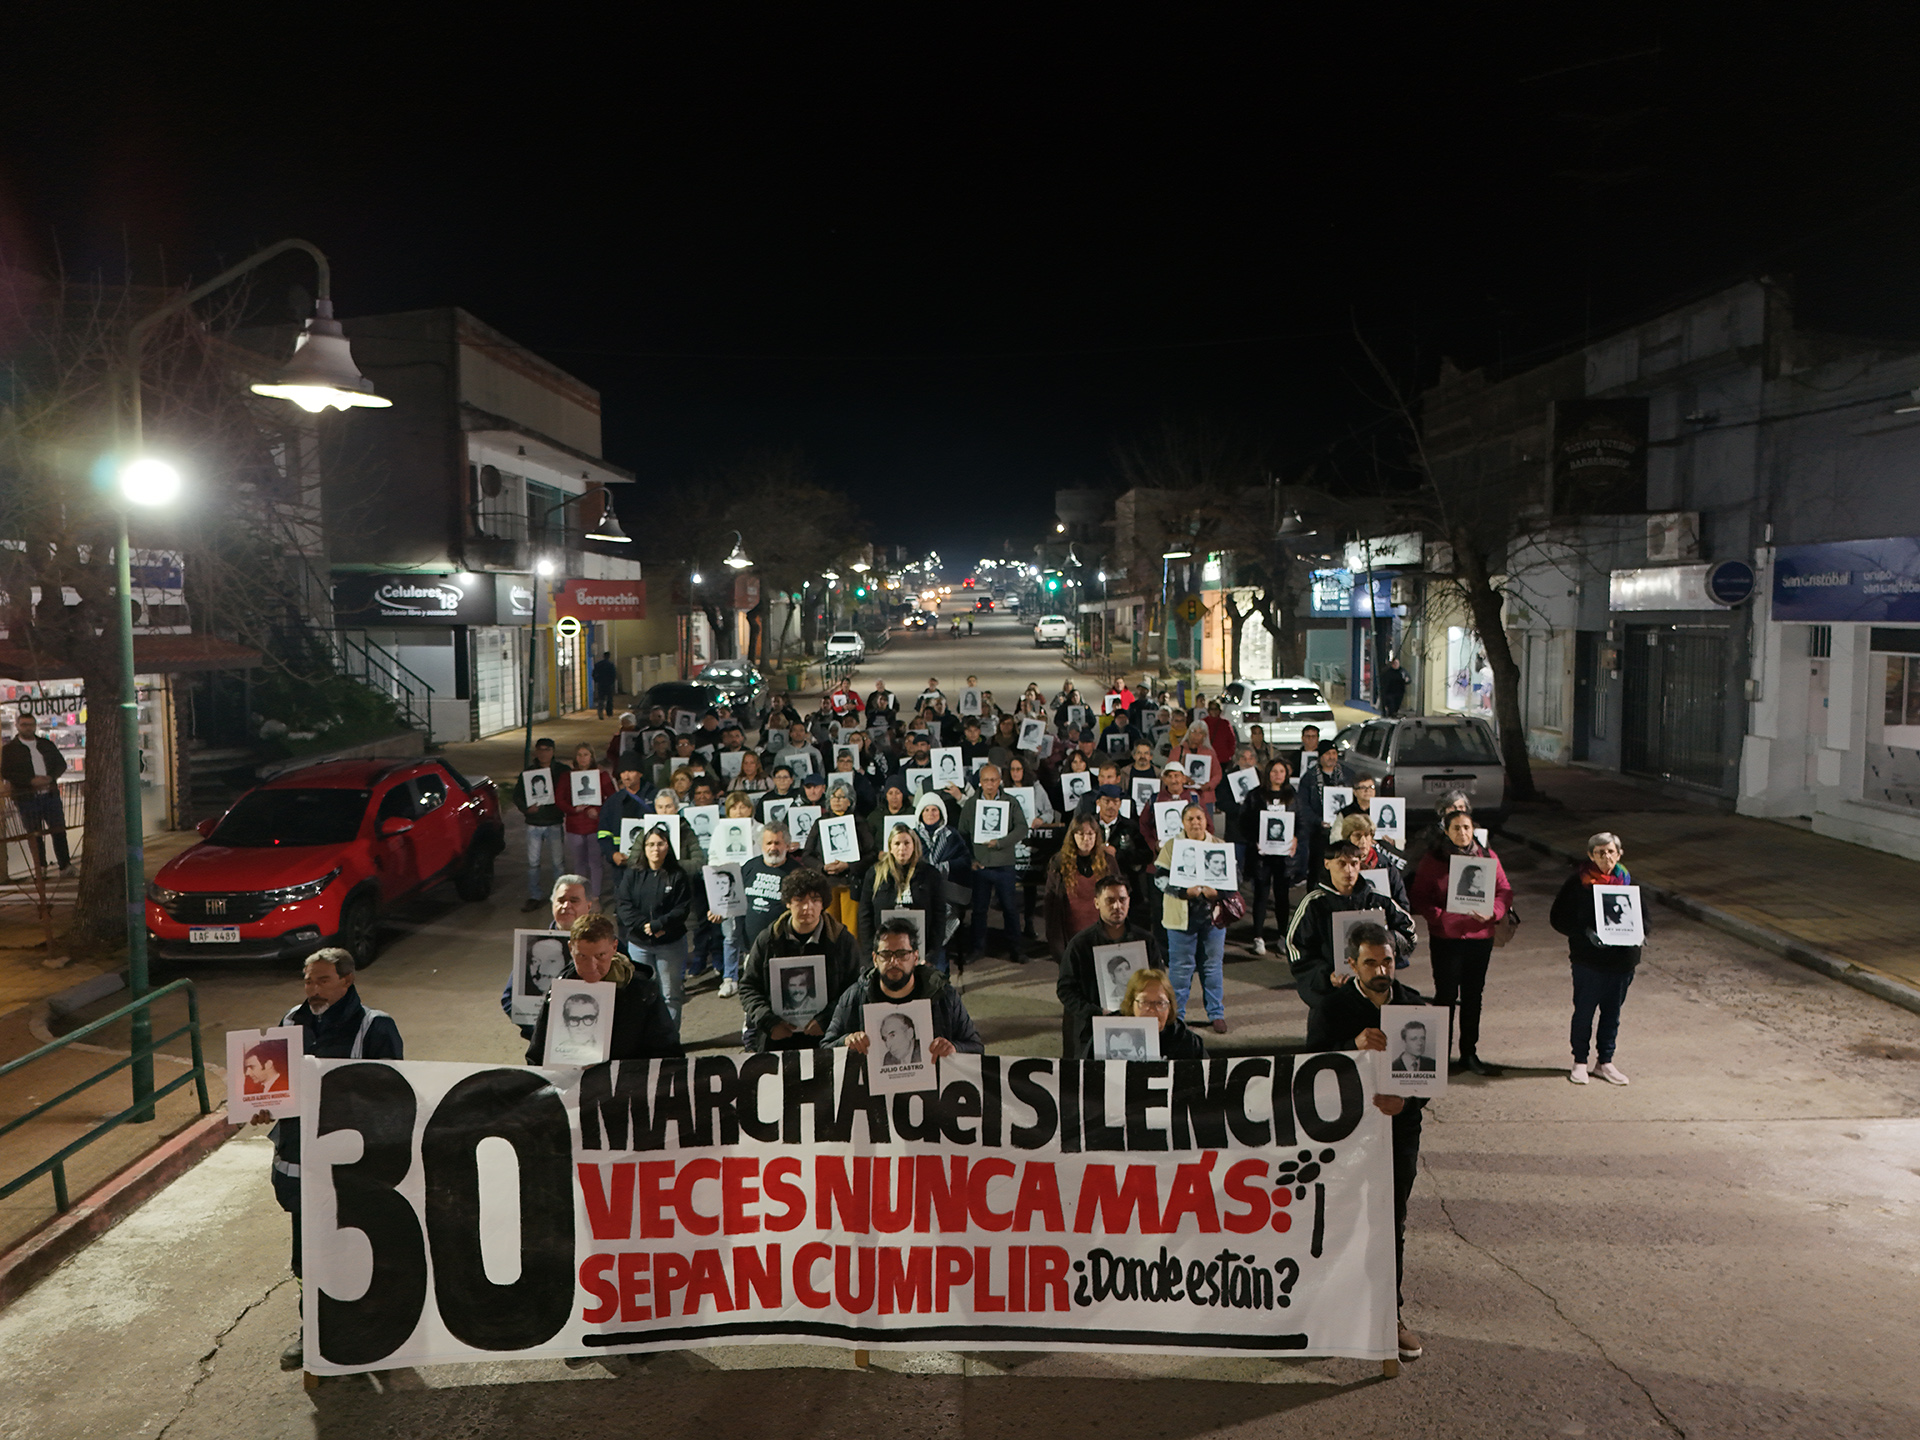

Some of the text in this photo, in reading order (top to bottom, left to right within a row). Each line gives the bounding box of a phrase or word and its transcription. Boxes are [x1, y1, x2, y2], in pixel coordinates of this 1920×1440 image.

[382, 584, 459, 610] Celulares 18
[577, 592, 639, 606] Bernachín
[1027, 829, 1053, 839] NTE
[205, 898, 228, 915] FIAT
[214, 932, 236, 941] 4489
[880, 1064, 924, 1074] JULIO CASTRO
[579, 1047, 891, 1152] MARCHA
[1007, 1052, 1364, 1153] SILENCIO
[576, 1157, 807, 1240] VECES
[815, 1154, 1066, 1235] NUNCA
[316, 1062, 576, 1365] 30
[579, 1243, 783, 1323] SEPAN
[792, 1241, 1071, 1316] CUMPLIR
[1186, 1247, 1300, 1311] están?
